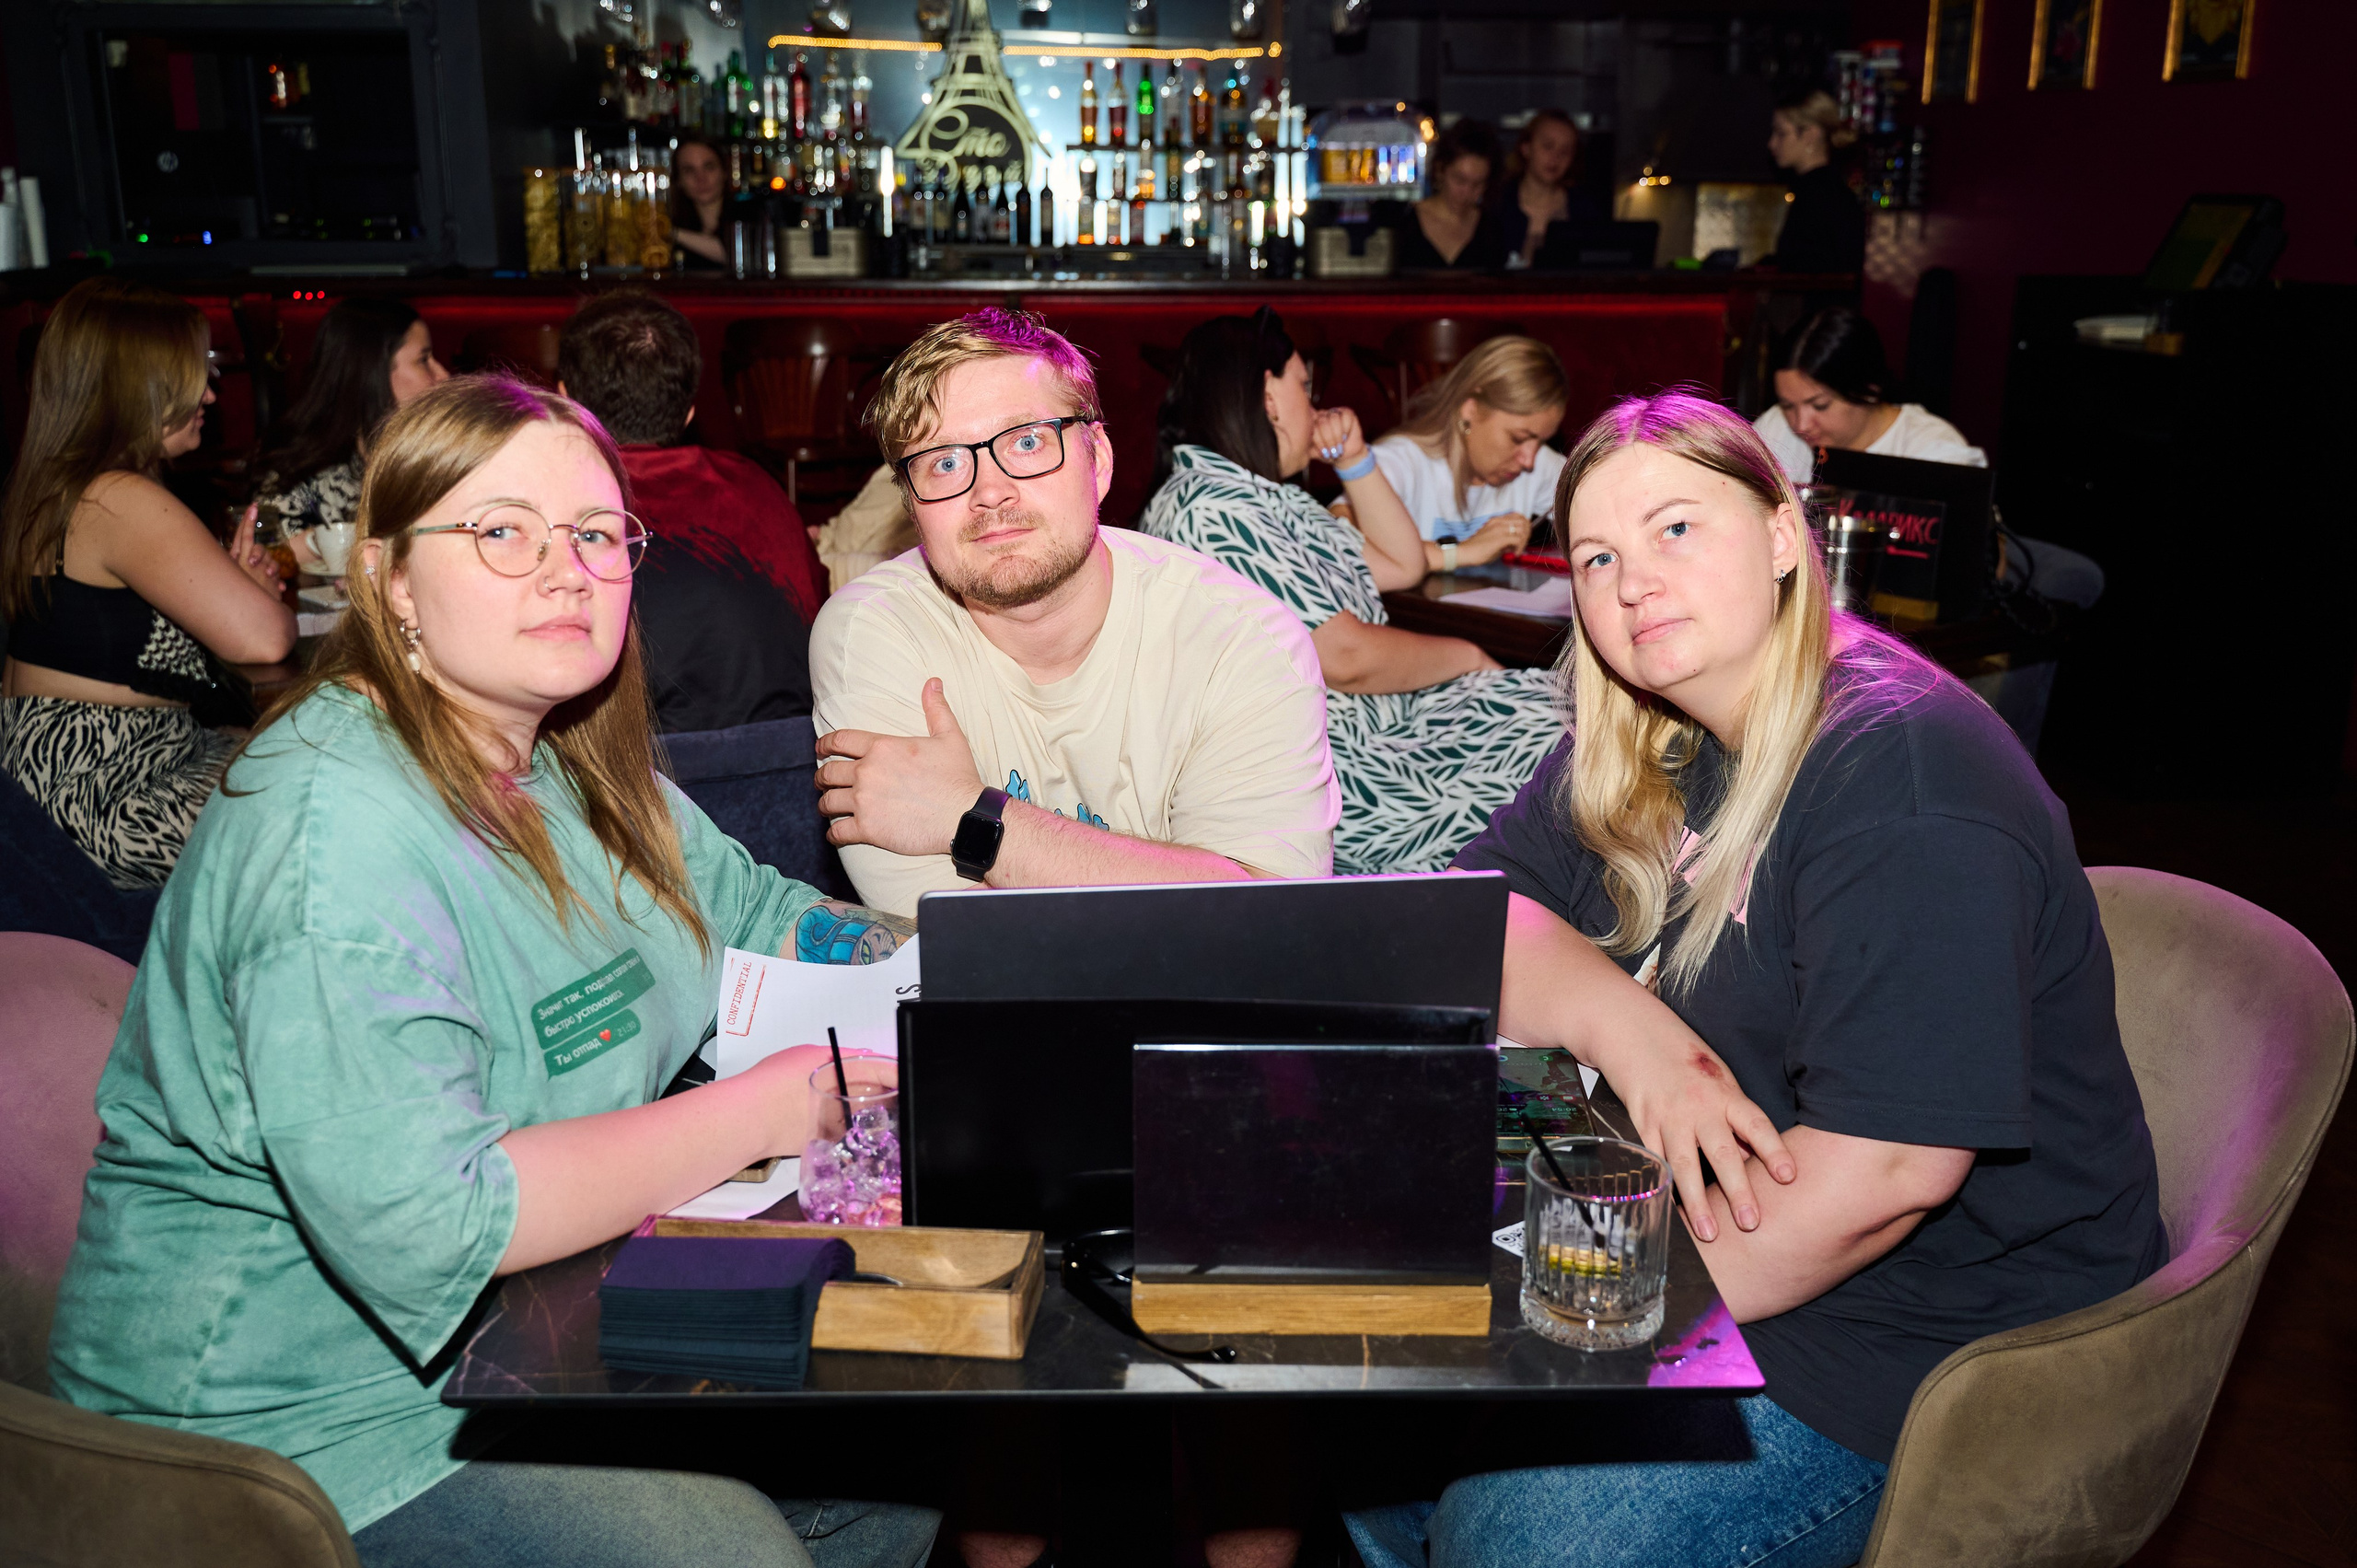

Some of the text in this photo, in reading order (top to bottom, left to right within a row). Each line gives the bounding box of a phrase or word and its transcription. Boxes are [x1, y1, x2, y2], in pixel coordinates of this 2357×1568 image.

[537, 1000, 563, 1020] Значит
[563, 991, 585, 1005] так,
[726, 961, 752, 1026] CONFIDENTIAL
[544, 1016, 575, 1037] быстро
[554, 1020, 636, 1066] Ты отпад 21:30
